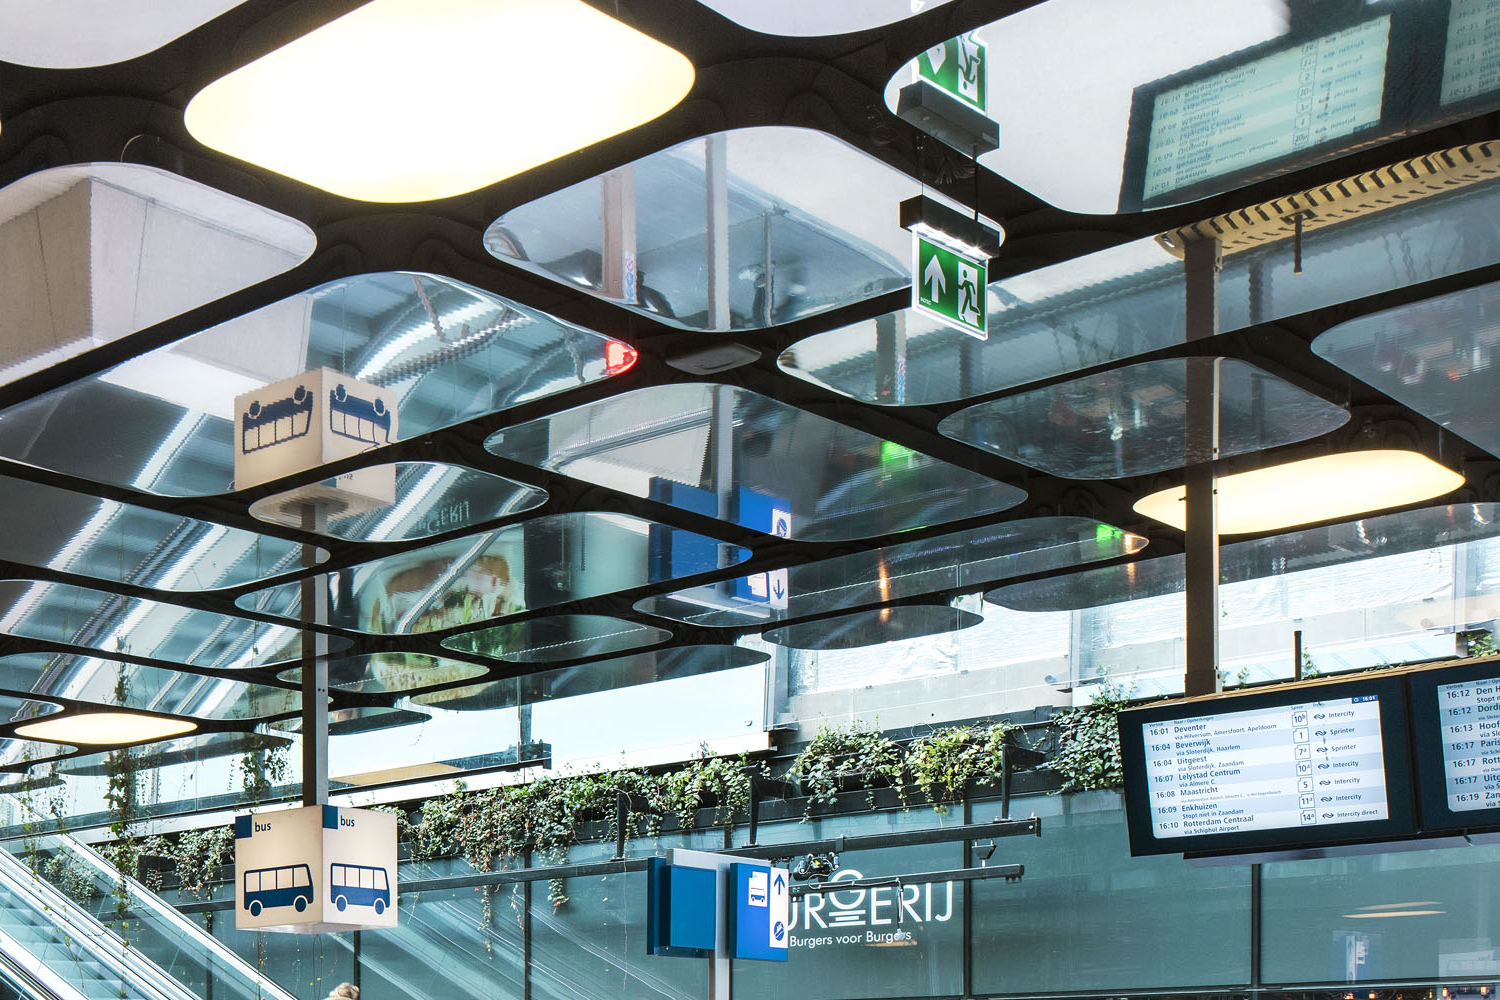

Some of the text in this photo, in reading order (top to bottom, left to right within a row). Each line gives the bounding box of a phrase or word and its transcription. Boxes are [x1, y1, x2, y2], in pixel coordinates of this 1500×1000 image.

[1447, 690, 1470, 698] 16:12
[1448, 703, 1500, 716] 16:12 Dord
[1150, 728, 1168, 736] 16:01
[1174, 724, 1206, 733] Deventer
[1328, 710, 1354, 718] Intercity
[1450, 724, 1472, 733] 16:13
[1214, 728, 1245, 736] Amersfoort,
[1248, 724, 1277, 732] Apeldoorn
[1152, 744, 1170, 752] 16:04
[1176, 739, 1211, 749] Beverwijk
[1330, 728, 1355, 736] Sprinter
[1452, 738, 1500, 750] 16:17 Paris
[1216, 744, 1240, 752] Haarlem
[1153, 760, 1172, 768] 16:04
[1177, 756, 1207, 766] Uitgeest
[1332, 744, 1356, 752] Sprinter
[1218, 760, 1244, 768] Zaandam
[1453, 759, 1476, 768] 16:17
[1154, 775, 1174, 783] 16:07
[1178, 771, 1208, 781] Lelystad
[1210, 768, 1240, 778] Centrum
[1332, 760, 1358, 768] Intercity
[1454, 776, 1478, 784] 16:17
[1156, 791, 1176, 799] 16:08
[1180, 786, 1218, 796] Maastricht
[1456, 793, 1479, 802] 16:19
[1158, 806, 1177, 814] 16:09
[1182, 803, 1218, 812] Enkhuizen
[1182, 812, 1198, 820] Stopt
[1218, 808, 1244, 816] Zaandam
[254, 822, 272, 832] bus
[340, 815, 355, 827] bus
[1160, 822, 1178, 830] 16:10
[1184, 818, 1222, 828] Rotterdam
[1224, 815, 1254, 824] Centraal
[790, 930, 912, 949] Burgers voor Burgs
